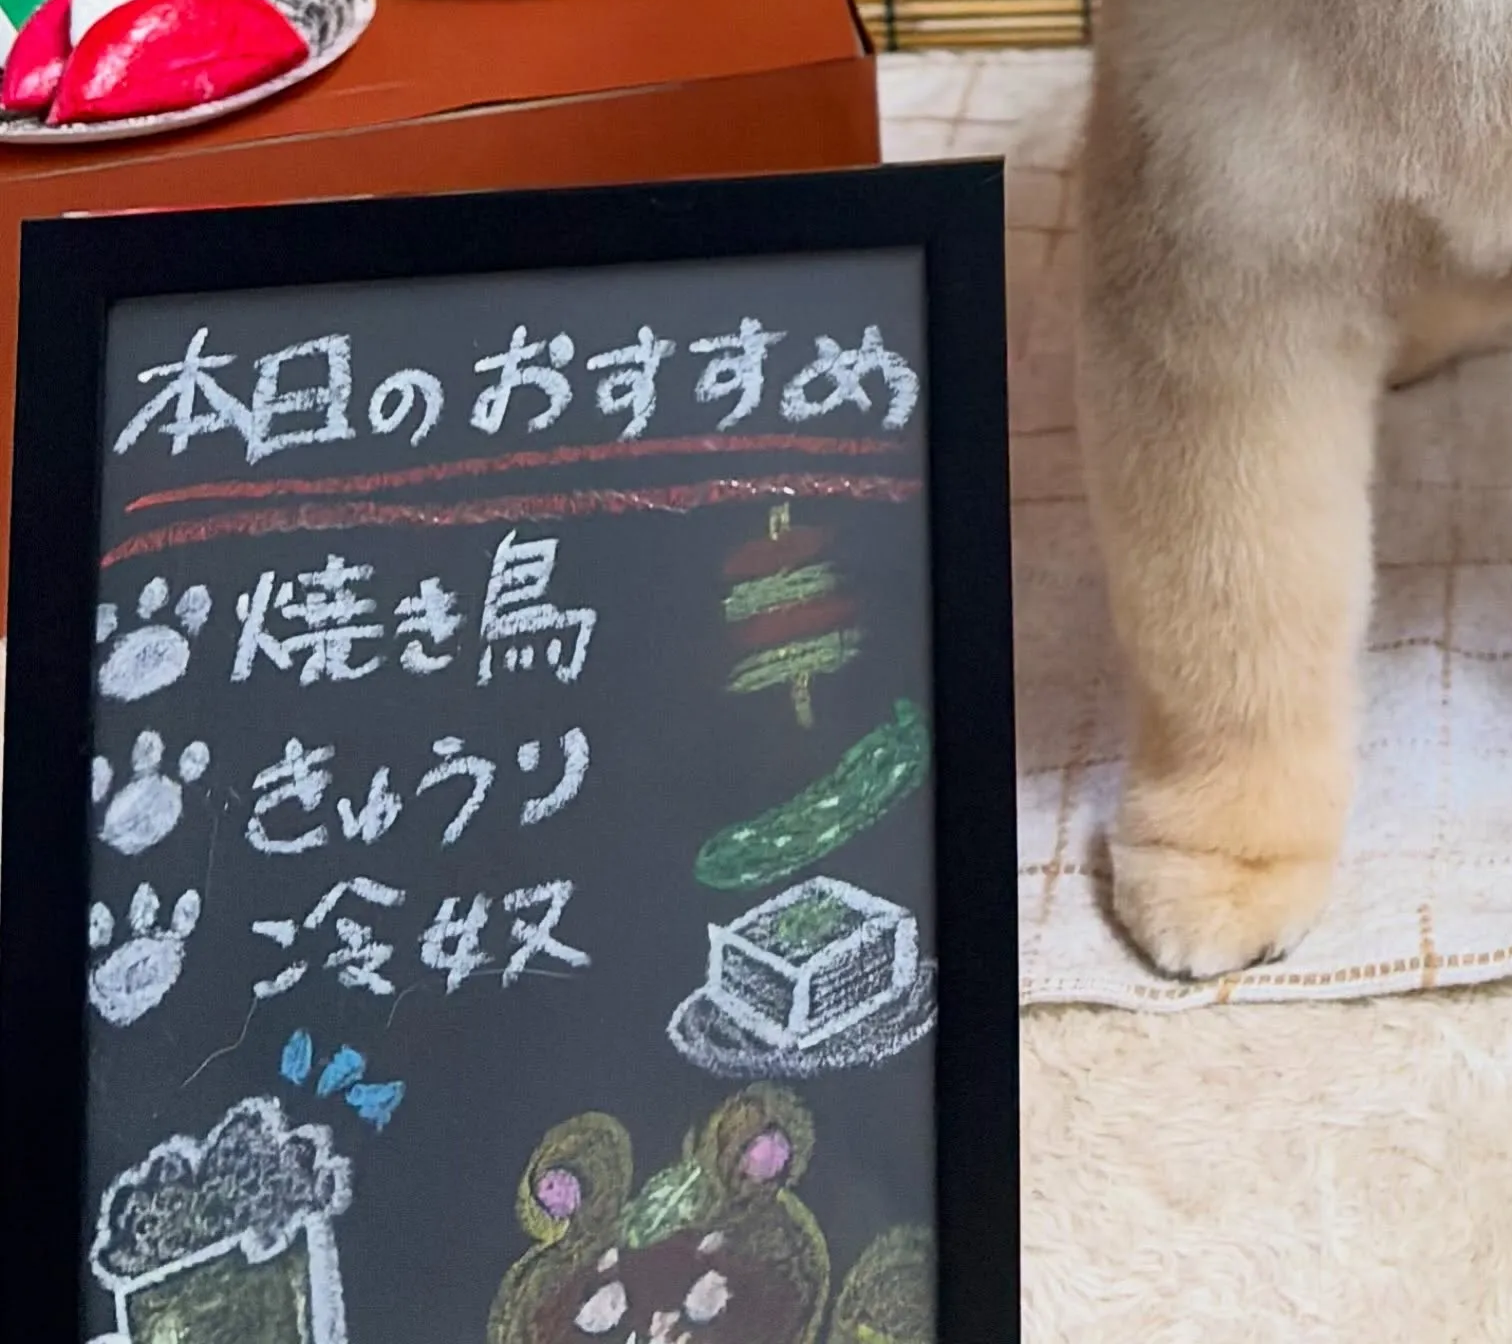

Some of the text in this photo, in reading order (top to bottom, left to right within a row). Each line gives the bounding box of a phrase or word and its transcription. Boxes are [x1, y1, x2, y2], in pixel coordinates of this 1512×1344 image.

[112, 316, 922, 464] 本日のおすすめ
[228, 530, 596, 686] 焼き鳥
[248, 876, 592, 998] 冷奴
